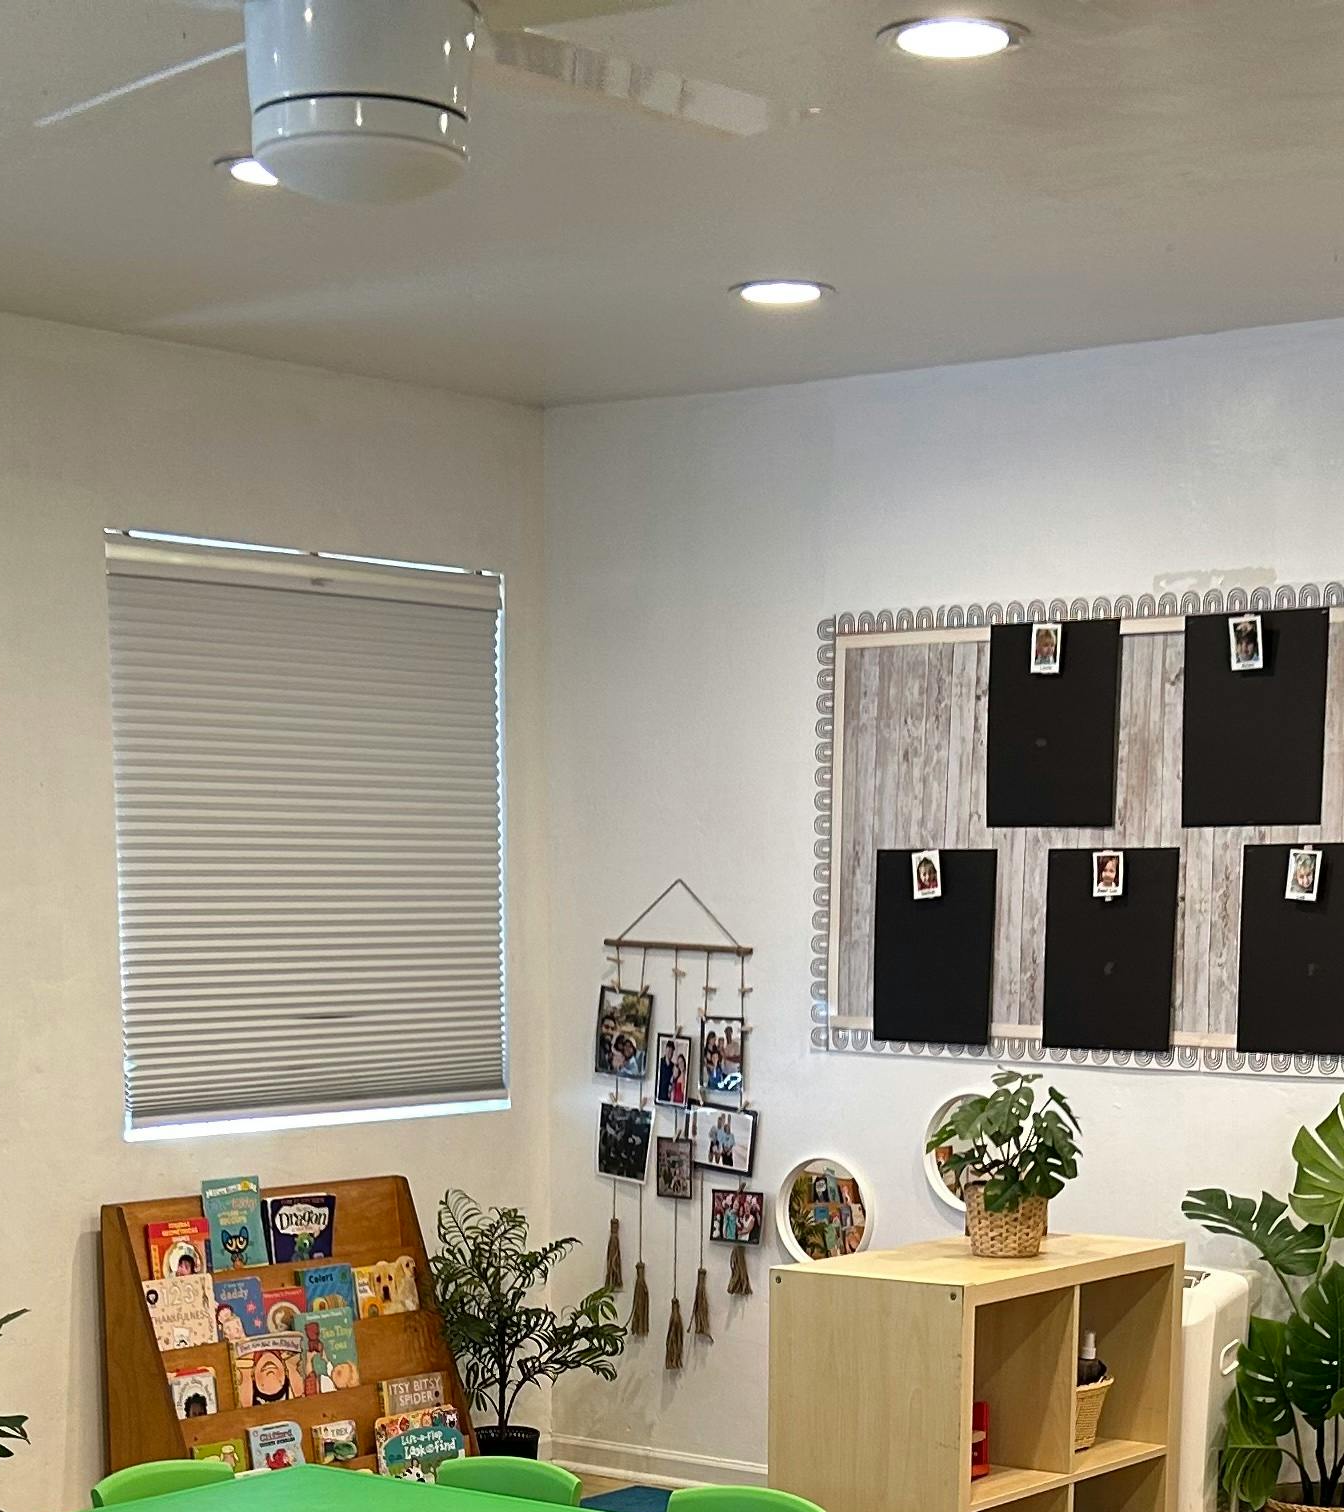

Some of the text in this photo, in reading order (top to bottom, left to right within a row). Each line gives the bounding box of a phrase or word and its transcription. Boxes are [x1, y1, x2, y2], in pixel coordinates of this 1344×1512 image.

[308, 1272, 334, 1285] Colors
[220, 1287, 249, 1301] daddy
[388, 1375, 441, 1395] ITSY BITSY
[399, 1390, 434, 1407] SPIDER
